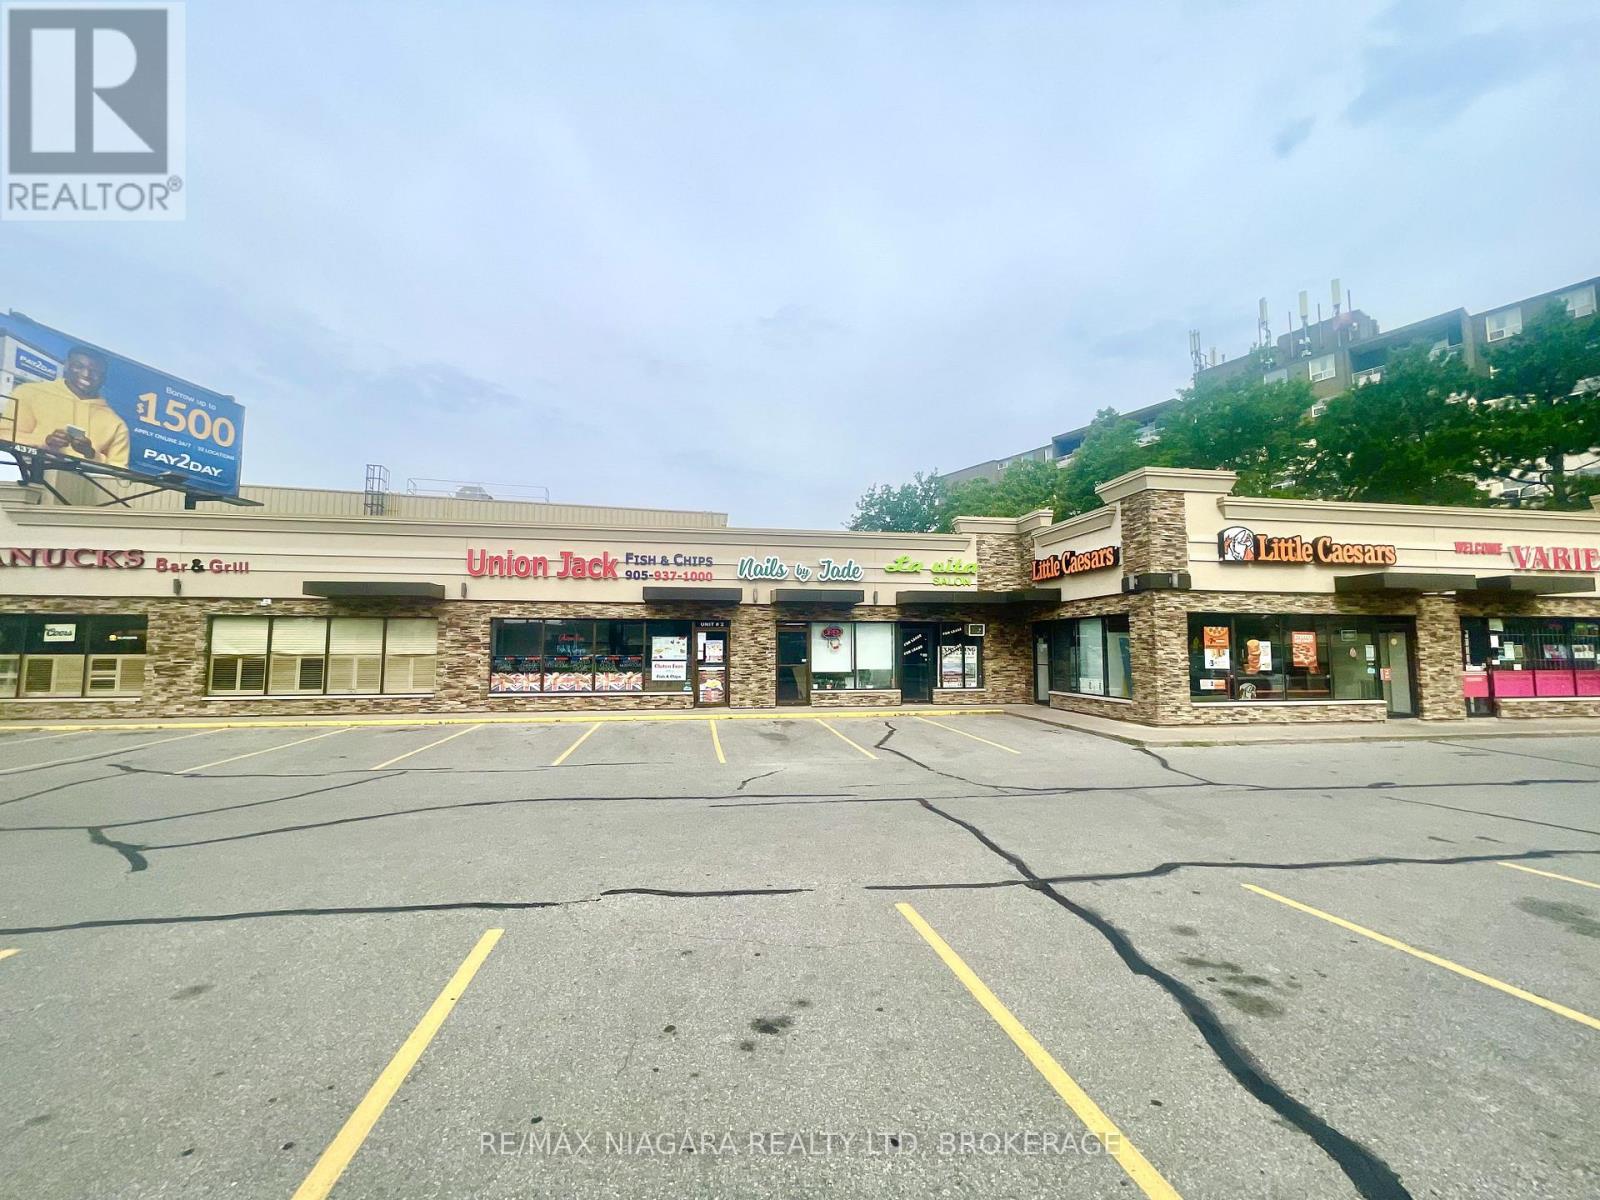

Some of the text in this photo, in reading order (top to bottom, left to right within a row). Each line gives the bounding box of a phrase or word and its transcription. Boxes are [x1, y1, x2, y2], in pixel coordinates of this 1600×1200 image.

[165, 386, 217, 411] Borrow up to
[134, 427, 154, 437] APPLY
[154, 433, 178, 444] ONLINE
[14, 444, 38, 455] 4375
[143, 448, 223, 477] PAY2DAY
[660, 555, 670, 566] &
[1258, 534, 1397, 566] Little Caesars
[466, 548, 619, 580] Union Jack
[738, 556, 864, 582] Nails by Jade
[884, 554, 924, 573] La
[1032, 546, 1116, 581] Little Caesars
[625, 569, 713, 581] 905-937-1000
[932, 576, 972, 586] SALON
